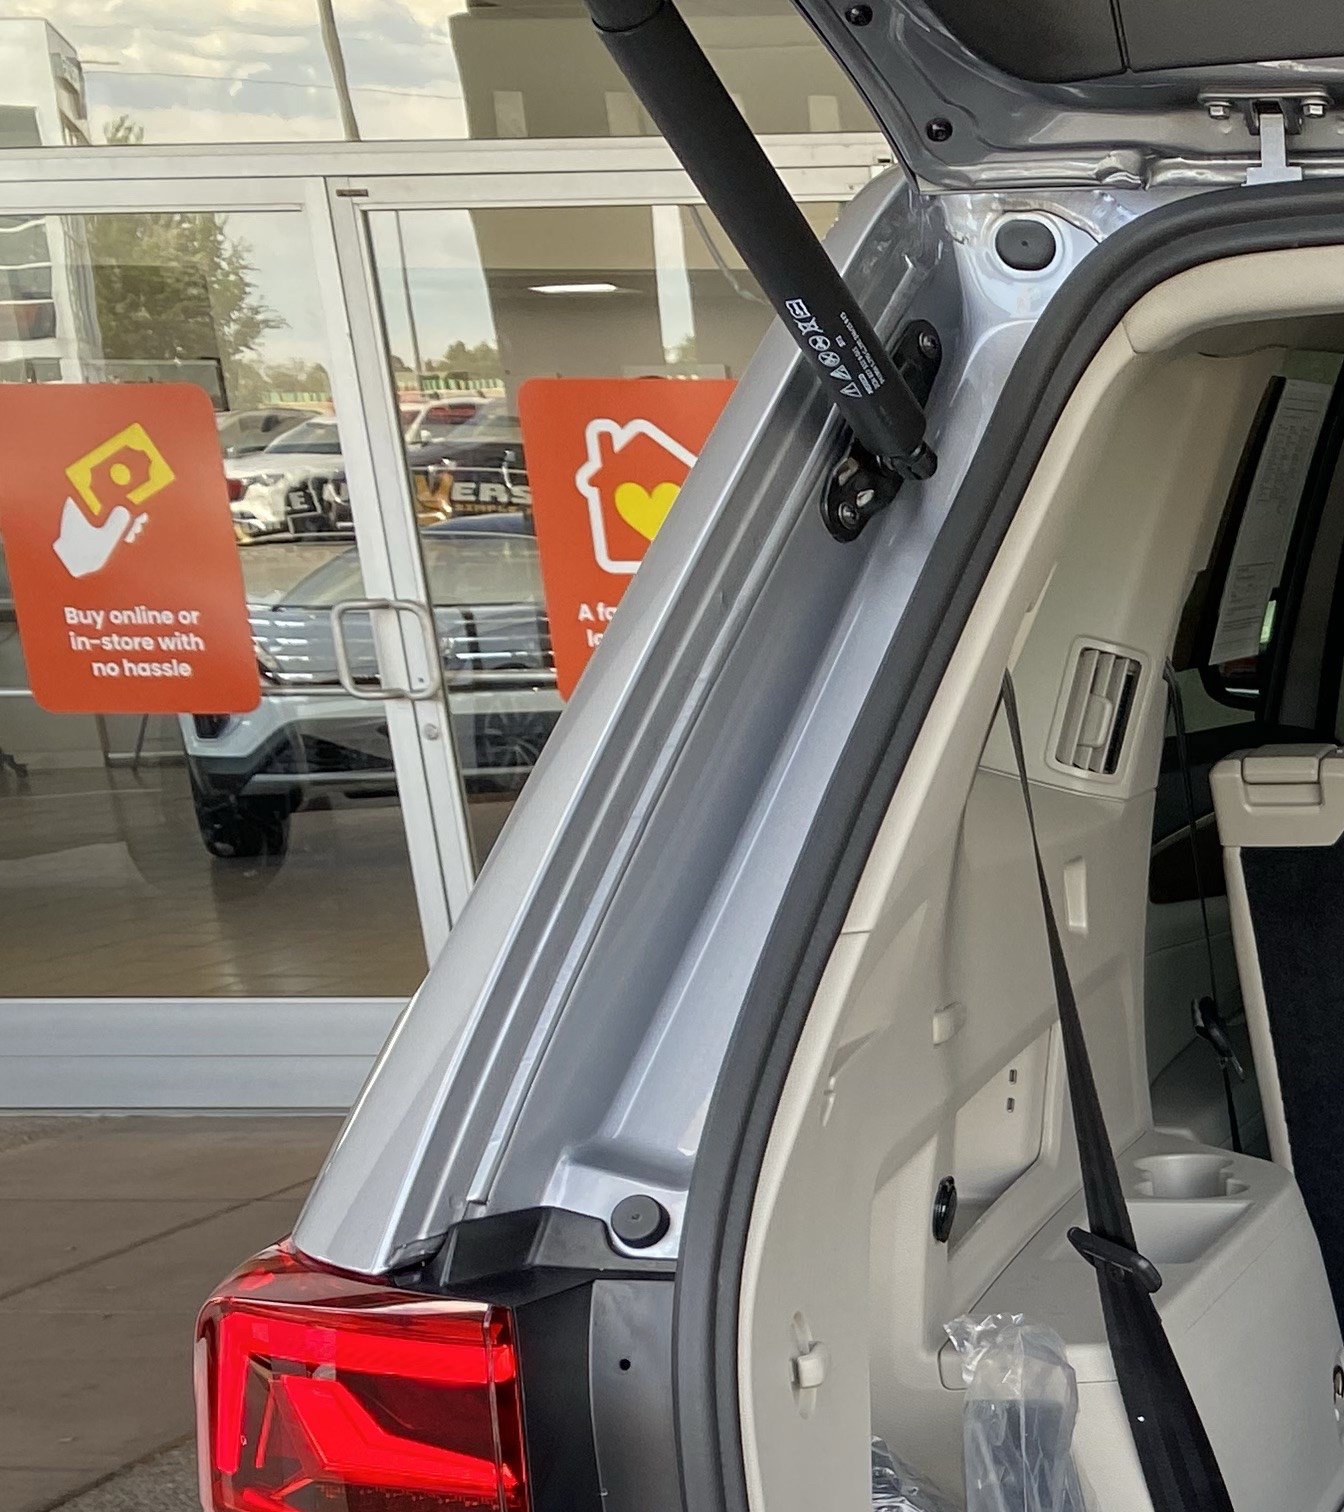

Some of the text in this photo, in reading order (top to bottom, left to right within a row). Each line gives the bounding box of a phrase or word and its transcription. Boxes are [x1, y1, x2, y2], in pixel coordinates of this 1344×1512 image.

[64, 605, 201, 630] Buy online or
[577, 602, 596, 622] A
[69, 630, 205, 651] in-store with
[92, 658, 193, 677] no hassle
